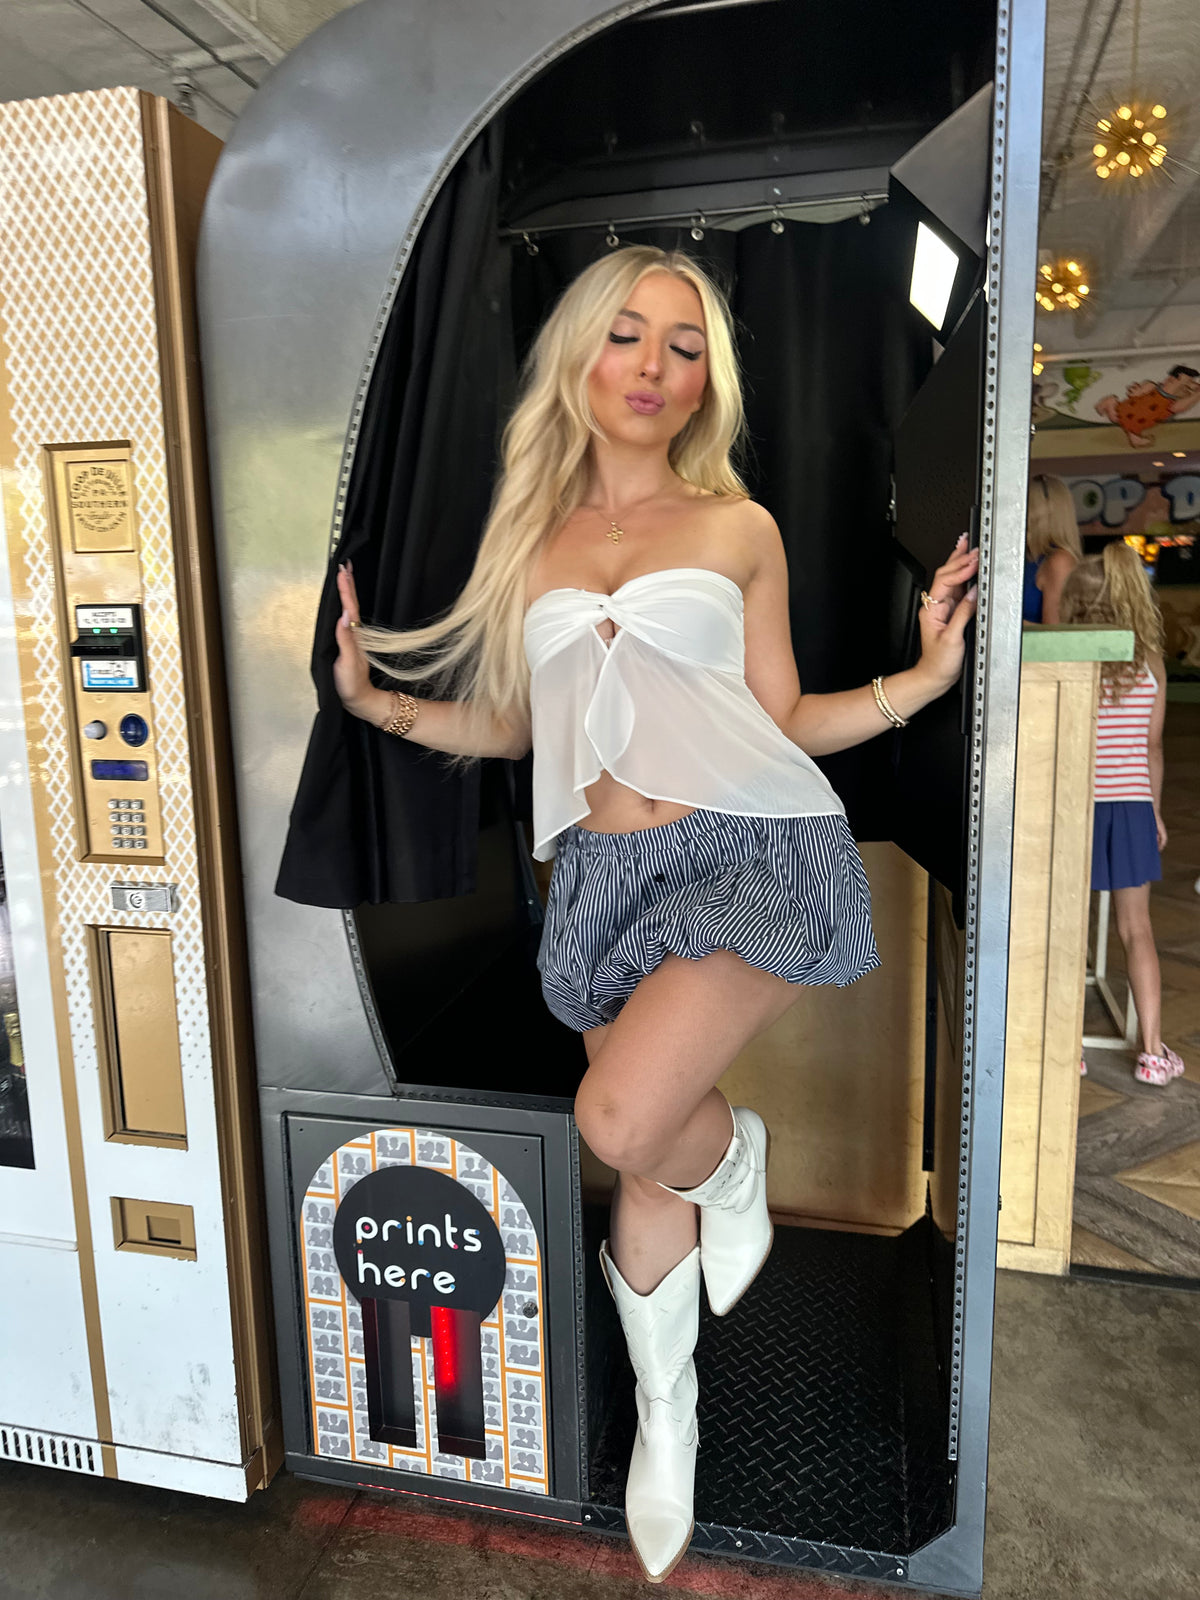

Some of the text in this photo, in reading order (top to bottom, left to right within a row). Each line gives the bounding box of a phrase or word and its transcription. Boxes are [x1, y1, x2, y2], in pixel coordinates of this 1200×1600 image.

[70, 500, 128, 509] SOUTHERN
[355, 1213, 482, 1252] prints
[357, 1249, 456, 1294] here
